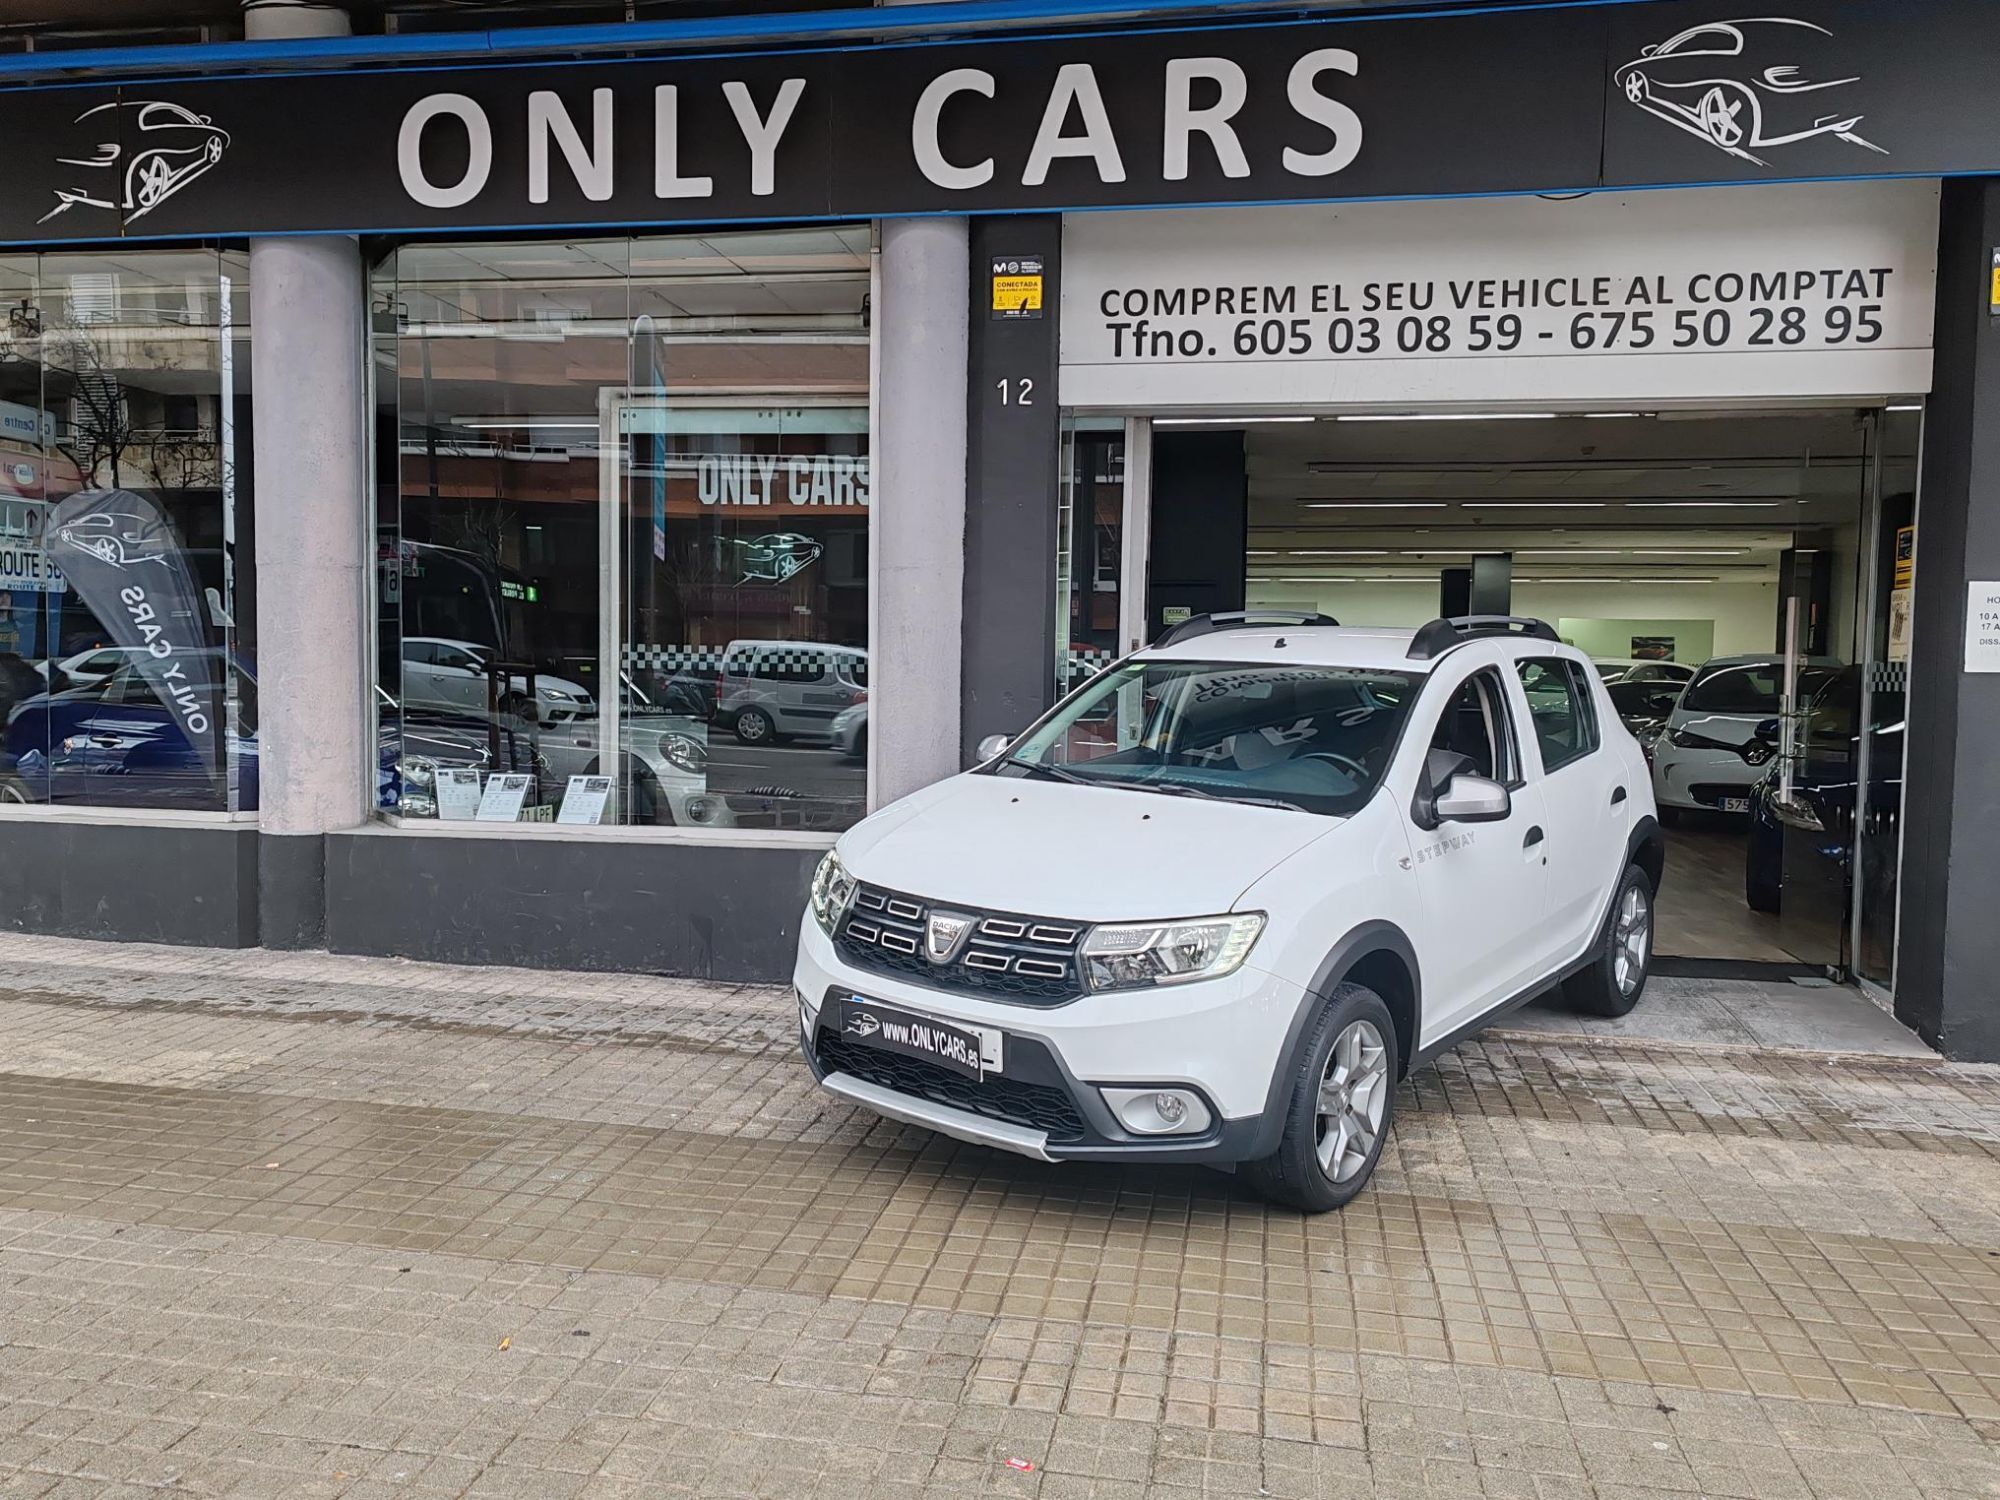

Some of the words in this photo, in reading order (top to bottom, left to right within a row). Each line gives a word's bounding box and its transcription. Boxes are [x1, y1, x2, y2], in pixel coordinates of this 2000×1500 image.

[397, 78, 806, 208] ONLY
[912, 48, 1363, 190] CARS
[1100, 285, 1297, 317] COMPREM
[1311, 284, 1350, 312] EL
[1362, 281, 1434, 311] SEU
[1448, 276, 1611, 309] VEHICLE
[1624, 275, 1674, 305] AL
[1687, 268, 1893, 303] COMPTAT
[1106, 320, 1217, 357] Tfno.
[1233, 318, 1312, 356] 605
[1327, 316, 1382, 354] 03
[1397, 315, 1451, 352] 08
[1467, 313, 1522, 351] 59
[1537, 331, 1554, 339] -
[1569, 310, 1655, 349] 675
[1672, 308, 1731, 347] 50
[1747, 306, 1806, 345] 28
[1823, 304, 1883, 344] 95
[997, 378, 1034, 406] 12
[698, 454, 777, 505] ONLY
[788, 455, 869, 506] CARS
[1979, 612, 1990, 620] 10
[1991, 612, 1999, 620] A
[1981, 623, 1991, 631] 17
[1979, 638, 2000, 646] DISS
[1416, 830, 1476, 864] STEPWAY
[932, 920, 958, 931] DACIA
[882, 1021, 979, 1069] www.ONLYCARS.es
